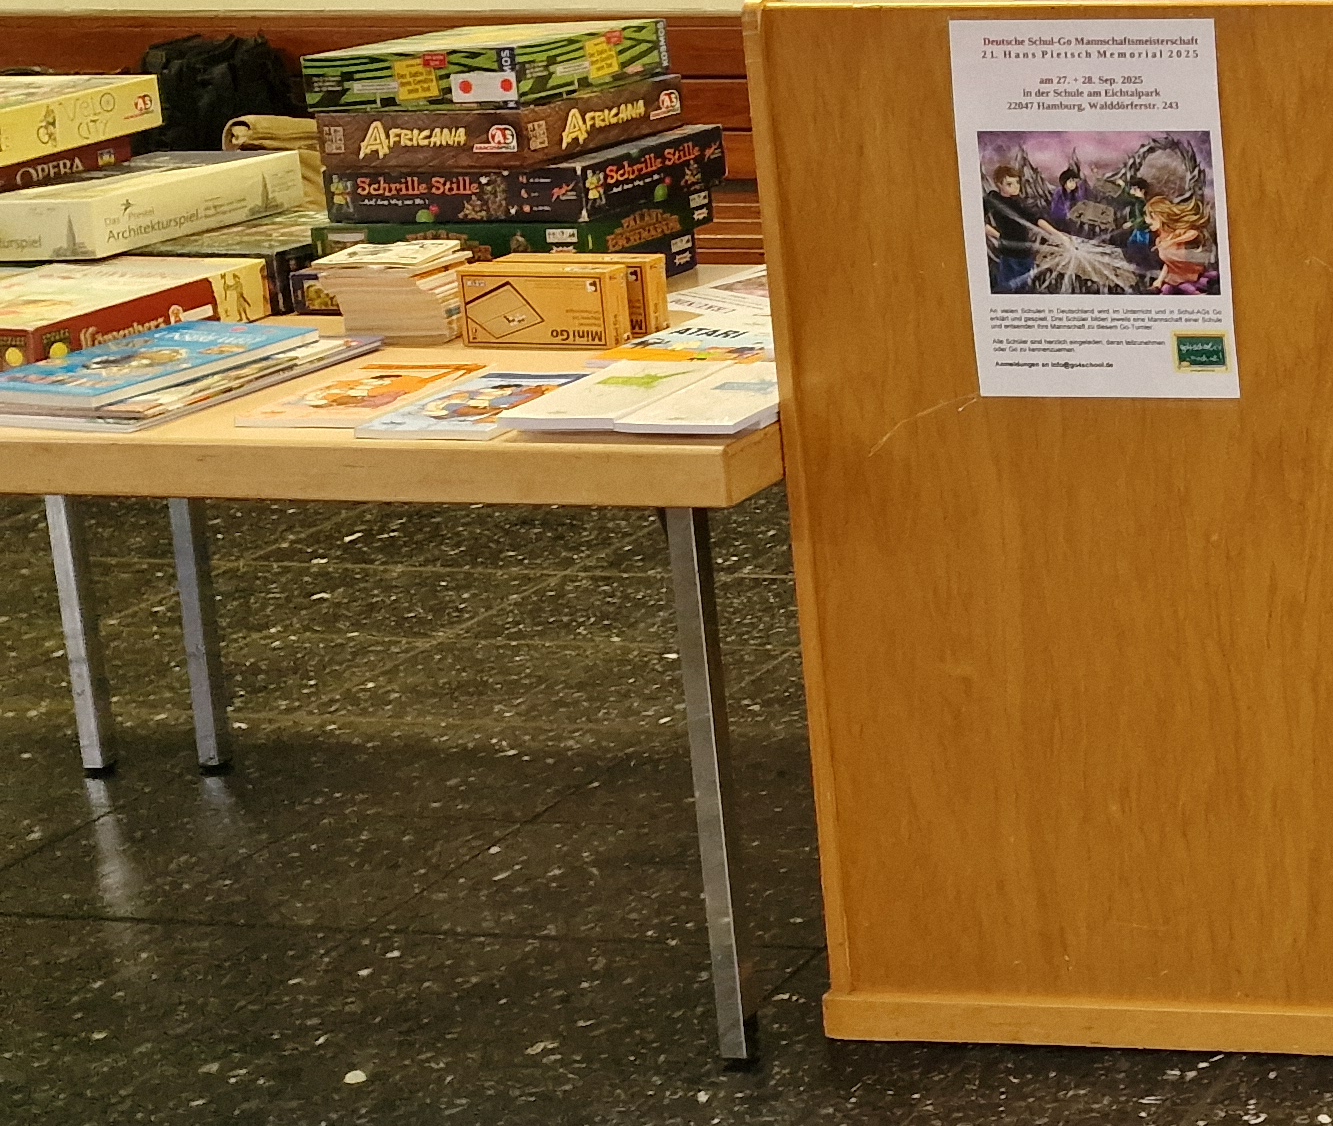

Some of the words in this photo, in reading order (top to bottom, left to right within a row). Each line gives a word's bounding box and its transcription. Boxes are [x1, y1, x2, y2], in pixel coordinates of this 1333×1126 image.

[983, 37, 1025, 46] Deutsche
[1028, 37, 1072, 46] Schul-Go
[1074, 36, 1199, 46] Mannschaftsmeisterschaft
[981, 50, 999, 59] 21.
[1003, 50, 1037, 59] Hans
[1041, 50, 1092, 59] Pietsch
[1097, 49, 1163, 59] Memorial
[1168, 49, 1199, 59] 2025
[1039, 77, 1054, 85] am
[1056, 75, 1070, 85] 27.
[1081, 75, 1096, 85] 28.
[1098, 75, 1119, 87] Sep.
[1121, 75, 1144, 85] 2025
[1022, 88, 1032, 98] in
[1035, 88, 1051, 98] der
[1053, 88, 1085, 98] Schule
[1087, 90, 1101, 98] am
[1104, 88, 1161, 100] Eichtalpark
[1006, 101, 1035, 111] 22047
[1037, 101, 1085, 112] Hamburg,
[1088, 100, 1160, 111] Walddörferstr.
[1162, 101, 1179, 110] 243
[561, 99, 646, 150] AFRICANA
[358, 121, 467, 160] AFRICANA
[605, 153, 663, 184] Schrille
[664, 141, 701, 167] Stille
[15, 156, 85, 187] OPERA
[356, 175, 428, 197] Schrille
[431, 175, 480, 196] Stille
[104, 215, 122, 226] Das
[106, 209, 200, 244] Architekturspiel
[550, 329, 571, 342] Go
[571, 329, 603, 343] Mini
[669, 327, 749, 339] ATARI
